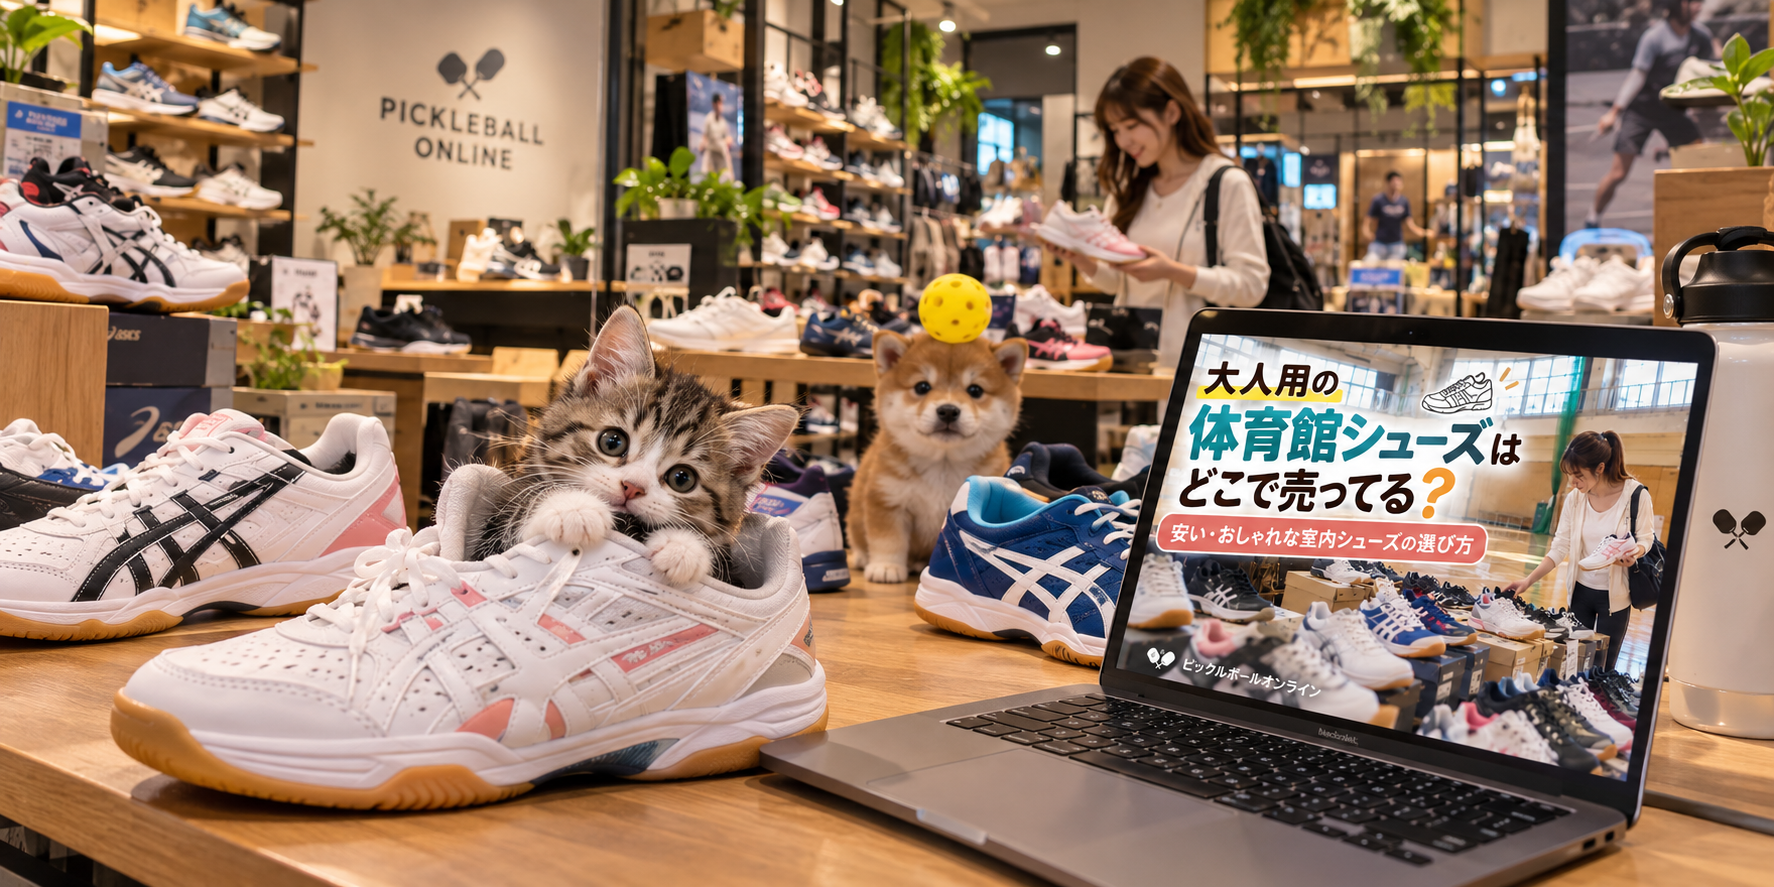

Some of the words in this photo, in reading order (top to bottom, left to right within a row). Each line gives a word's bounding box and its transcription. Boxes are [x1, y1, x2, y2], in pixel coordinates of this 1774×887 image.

[380, 96, 544, 145] PICKLEBALL
[415, 136, 512, 170] ONLINE
[1203, 361, 1339, 398] 大人用の
[1189, 404, 1522, 466] 体育館シューズは
[1170, 523, 1475, 555] 安い・おしゃれな室内シューズの選び方
